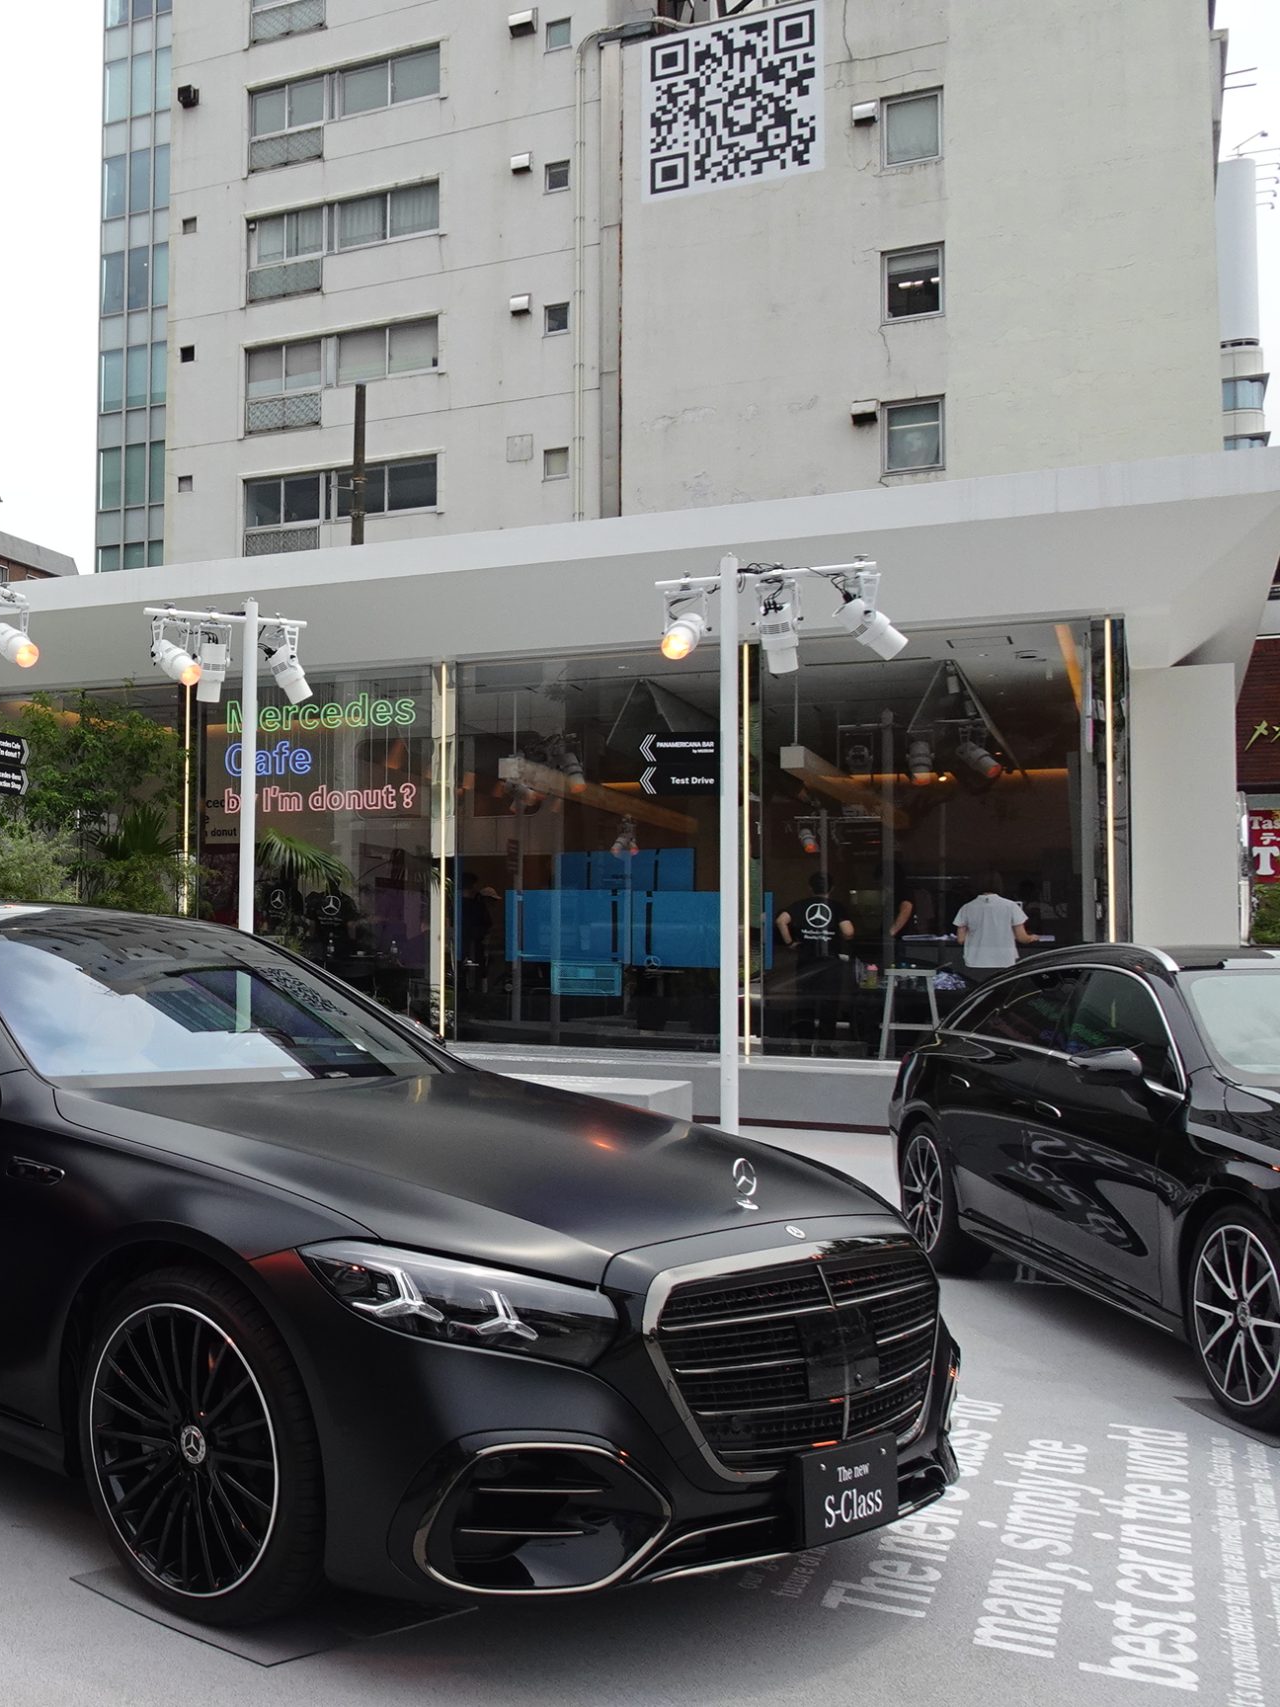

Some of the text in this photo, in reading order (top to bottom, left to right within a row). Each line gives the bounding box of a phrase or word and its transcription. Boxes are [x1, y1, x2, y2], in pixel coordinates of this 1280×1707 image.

[227, 693, 416, 733] Mercedes
[225, 740, 312, 778] Cafe
[225, 783, 416, 814] b I'm donut ?
[670, 777, 714, 785] Test Drive
[837, 1462, 870, 1482] The new
[1207, 1465, 1236, 1489] S-Class
[825, 1488, 883, 1529] S-Class
[878, 1503, 963, 1562] new
[972, 1438, 1105, 1659] many, simply the
[1079, 1423, 1199, 1692] best car in the world
[821, 1559, 942, 1618] The
[1219, 1583, 1251, 1606] that
[1219, 1604, 1260, 1672] coincidence
[1233, 1672, 1262, 1691] no
